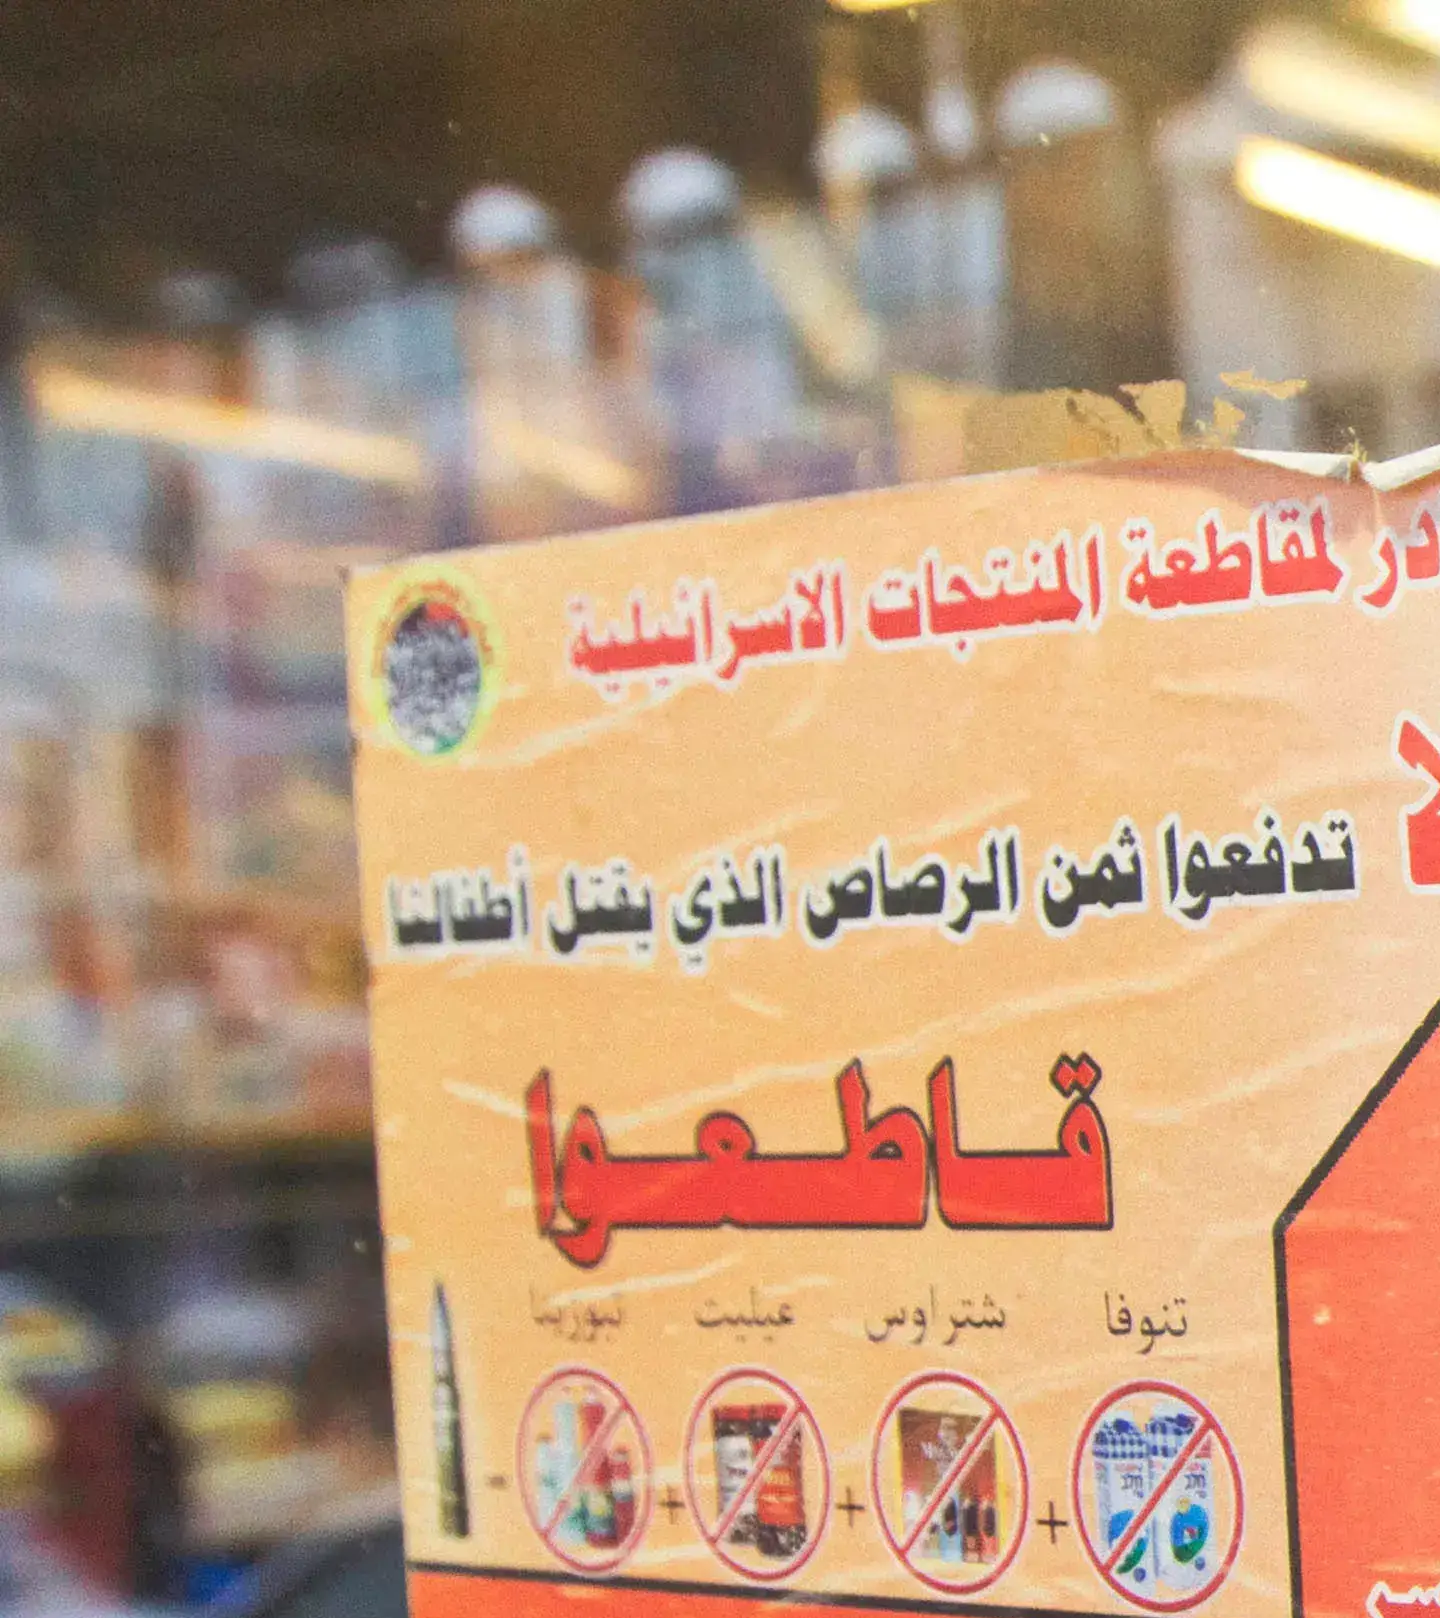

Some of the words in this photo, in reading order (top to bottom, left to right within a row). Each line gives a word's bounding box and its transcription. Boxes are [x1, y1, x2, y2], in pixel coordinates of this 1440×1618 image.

[864, 534, 1103, 651] المنتجات
[1125, 498, 1343, 611] لمقاطعة
[568, 570, 846, 692] الاسرائيلية
[386, 846, 528, 948] أطفالنا
[549, 868, 653, 956] يقتل
[670, 845, 782, 968] الذي
[807, 838, 1018, 938] الرصاص
[1040, 821, 1145, 928] ثمن
[1165, 813, 1357, 923] تدفعوا
[864, 1283, 1006, 1345] شتراوس
[1103, 1290, 1188, 1354] تنوفا
